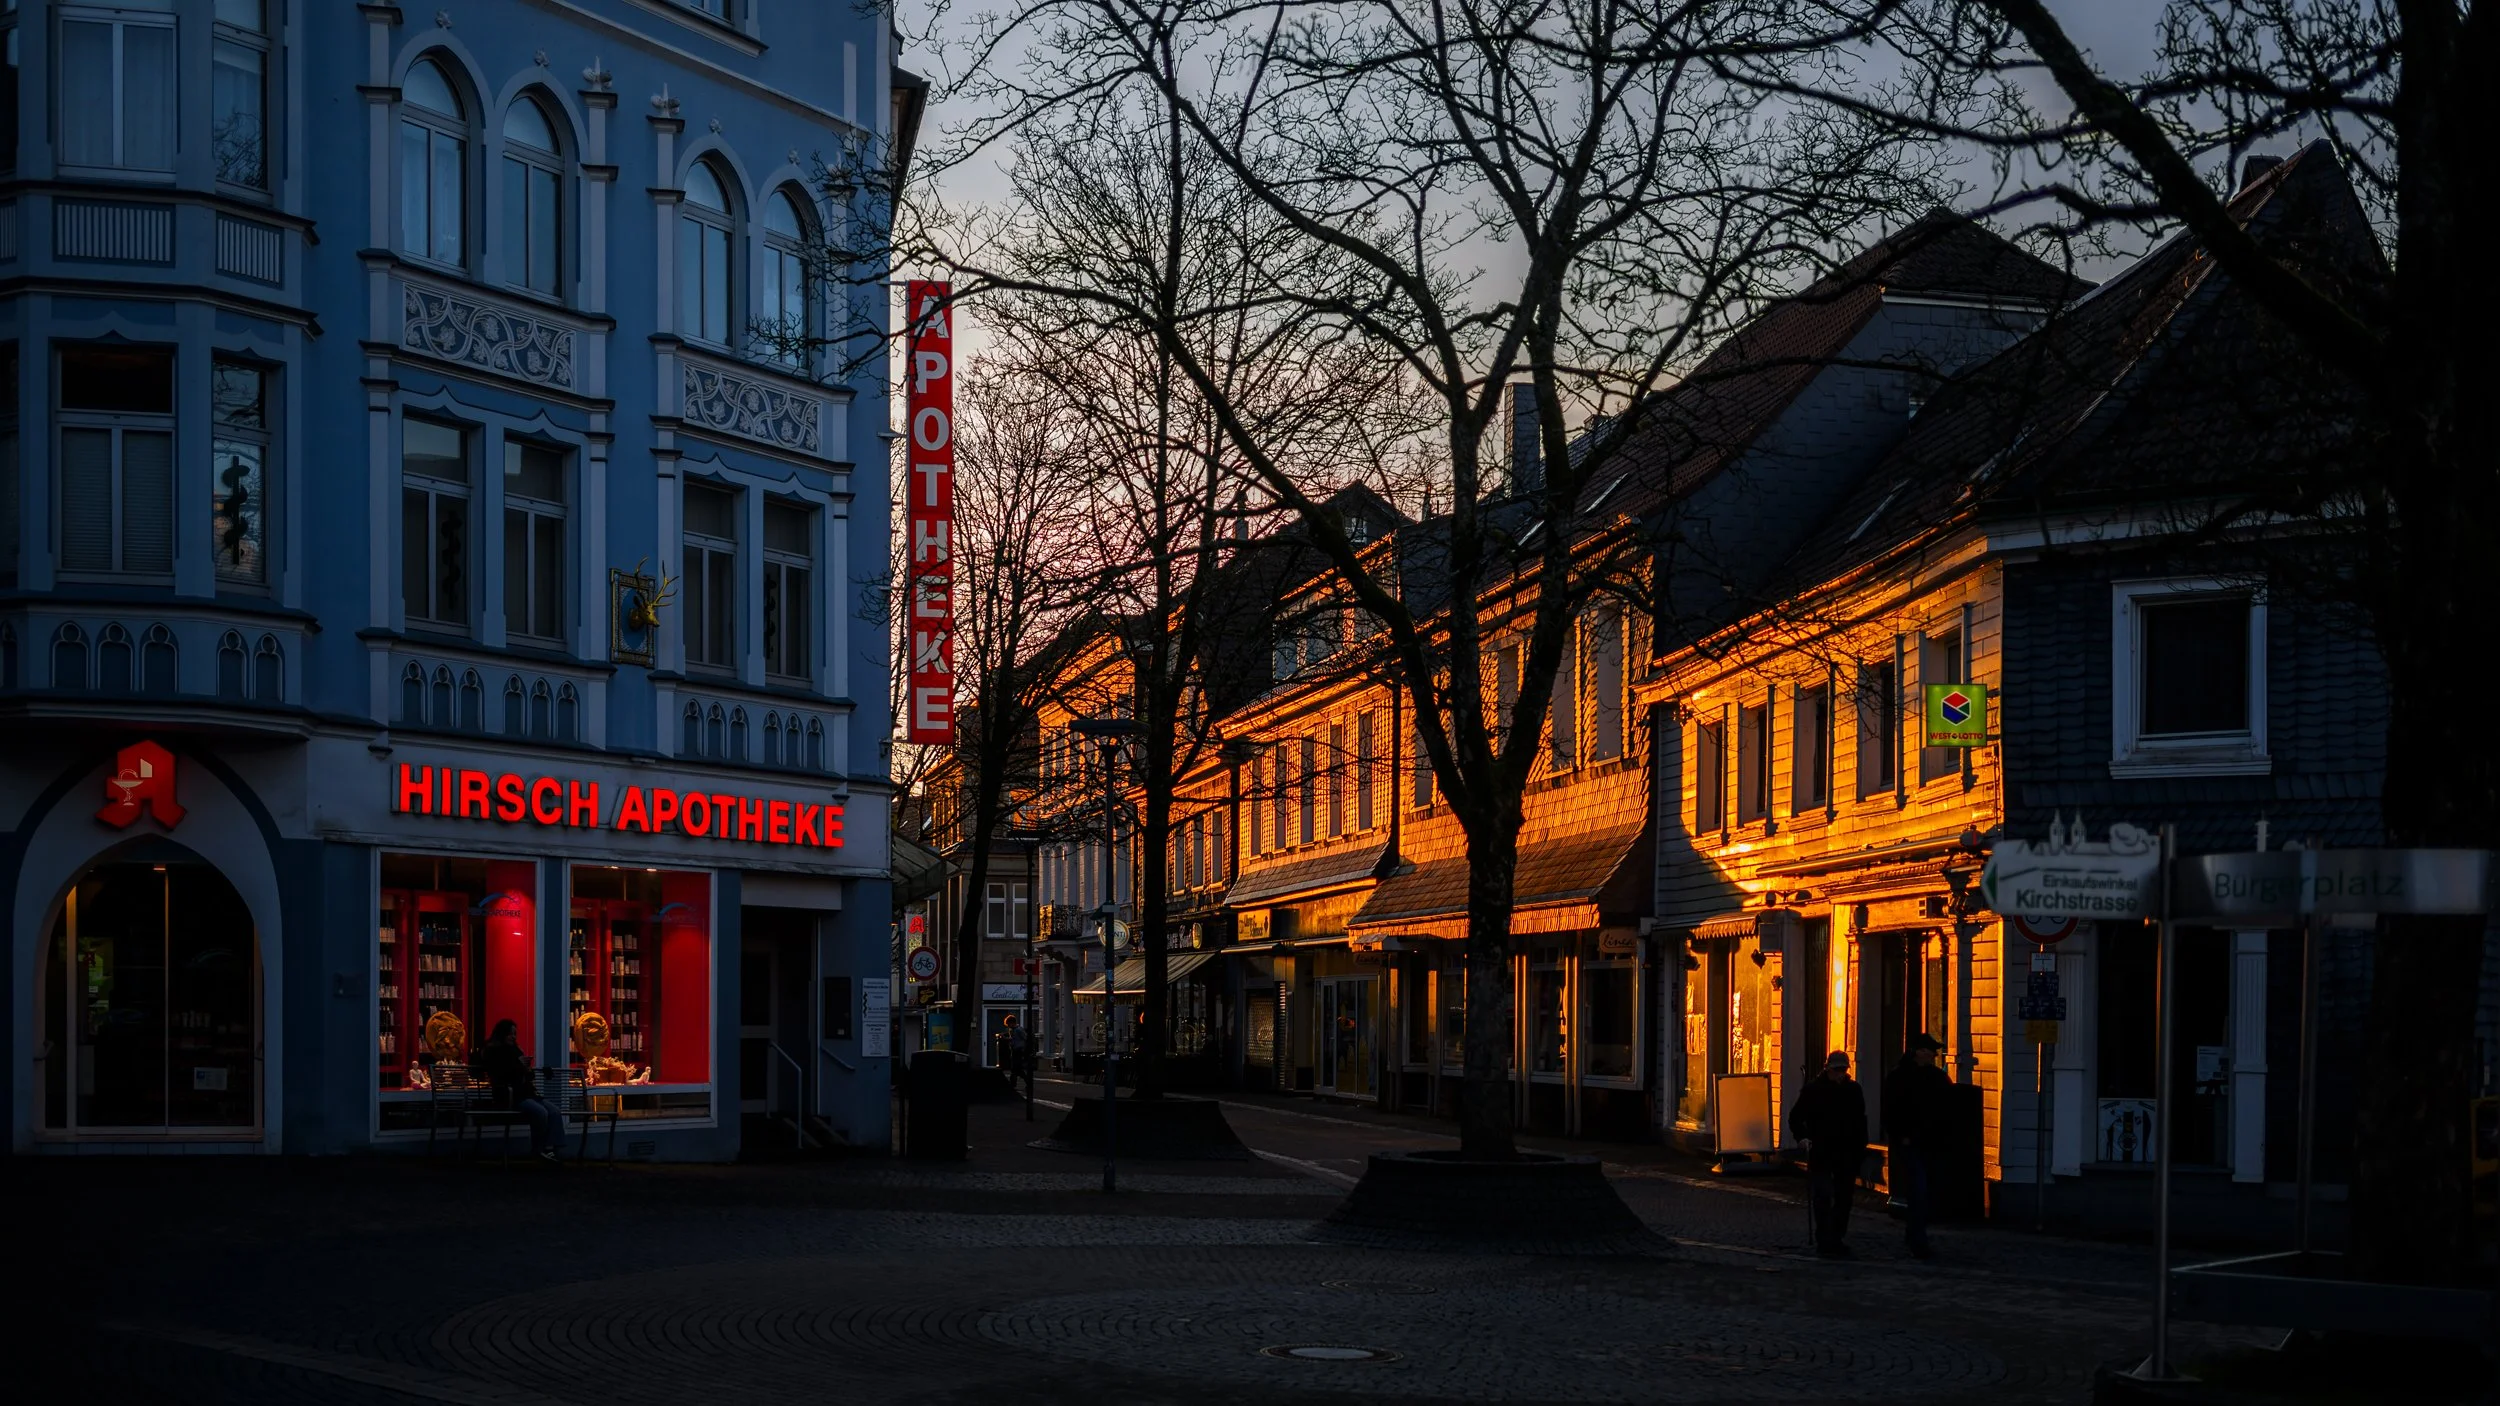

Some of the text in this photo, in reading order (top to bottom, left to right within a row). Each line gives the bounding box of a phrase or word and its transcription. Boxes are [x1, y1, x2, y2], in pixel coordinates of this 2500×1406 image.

[913, 295, 950, 730] APOTHEKE
[1929, 732, 1984, 740] WEST LOTTO
[395, 763, 845, 848] HIRSCH APOTHEKE
[2042, 874, 2138, 891] Einkaufswinkel
[2214, 872, 2404, 903] Bürgerplatz
[2016, 889, 2137, 912] Kirchstrasse
